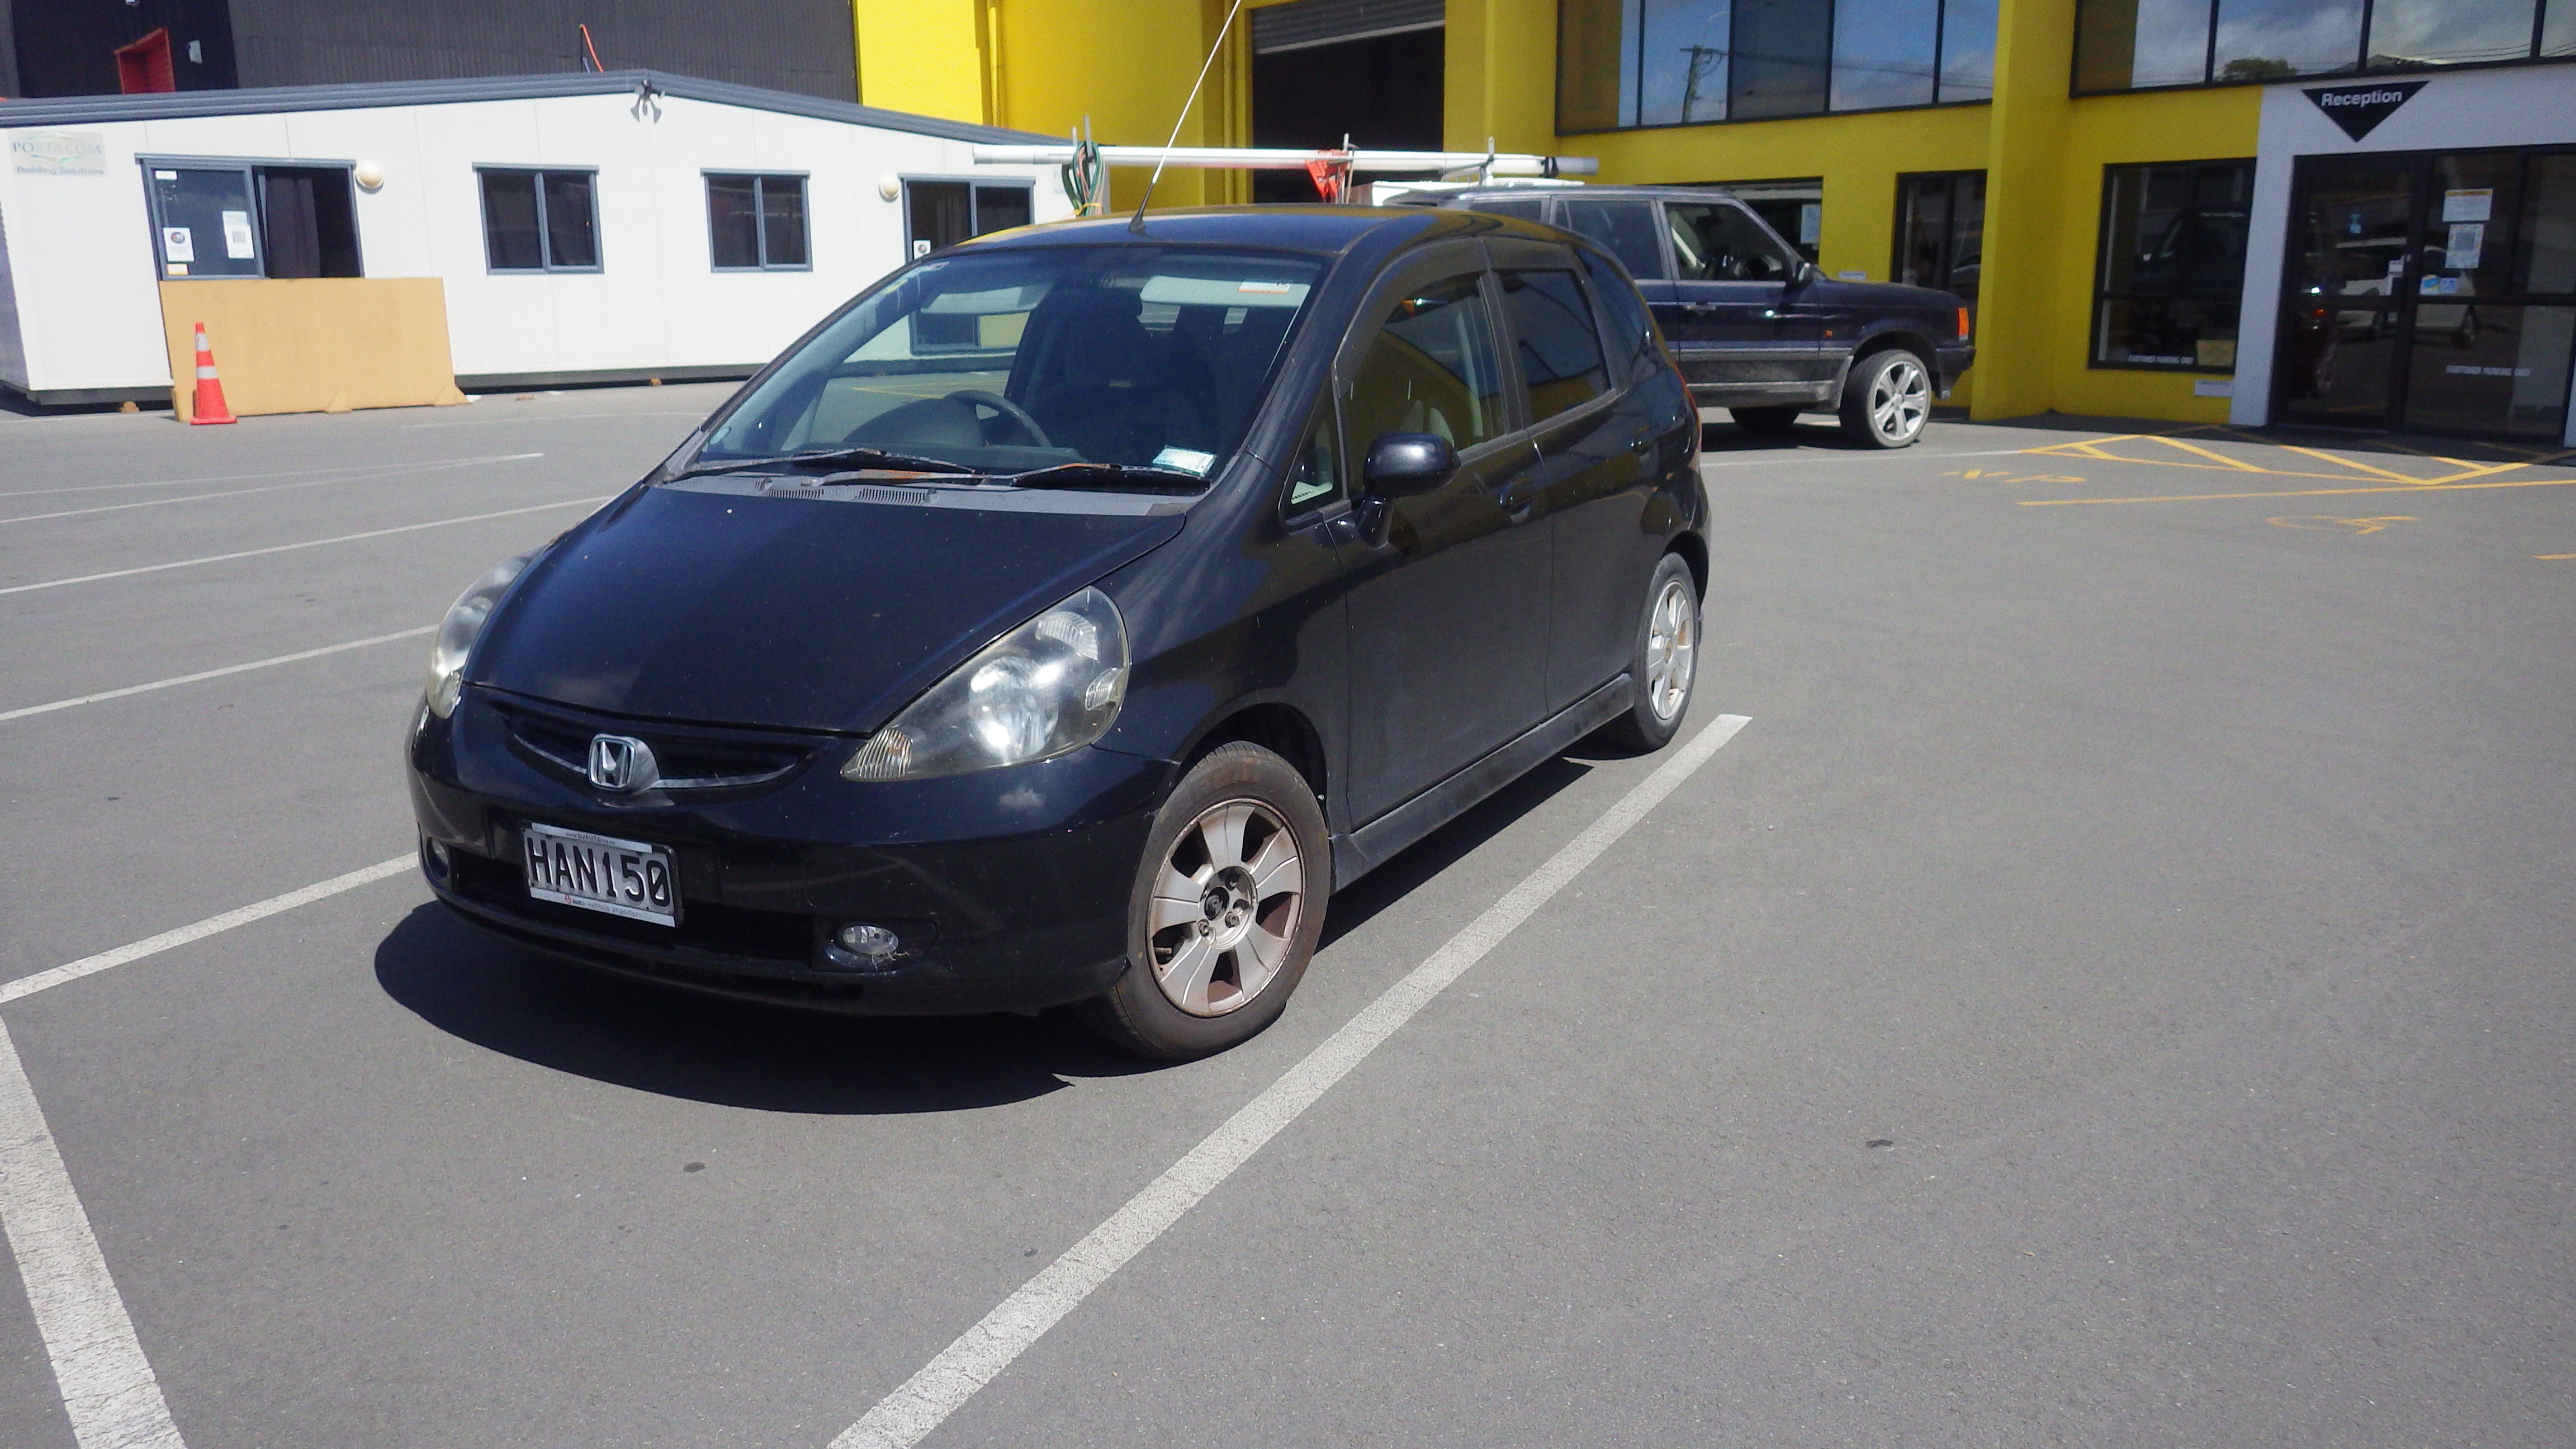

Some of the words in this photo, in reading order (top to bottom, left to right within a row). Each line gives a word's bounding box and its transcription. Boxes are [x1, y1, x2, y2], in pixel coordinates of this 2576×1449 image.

[2321, 89, 2403, 107] Reception
[17, 166, 56, 175] Building
[527, 837, 670, 907] HAN150
